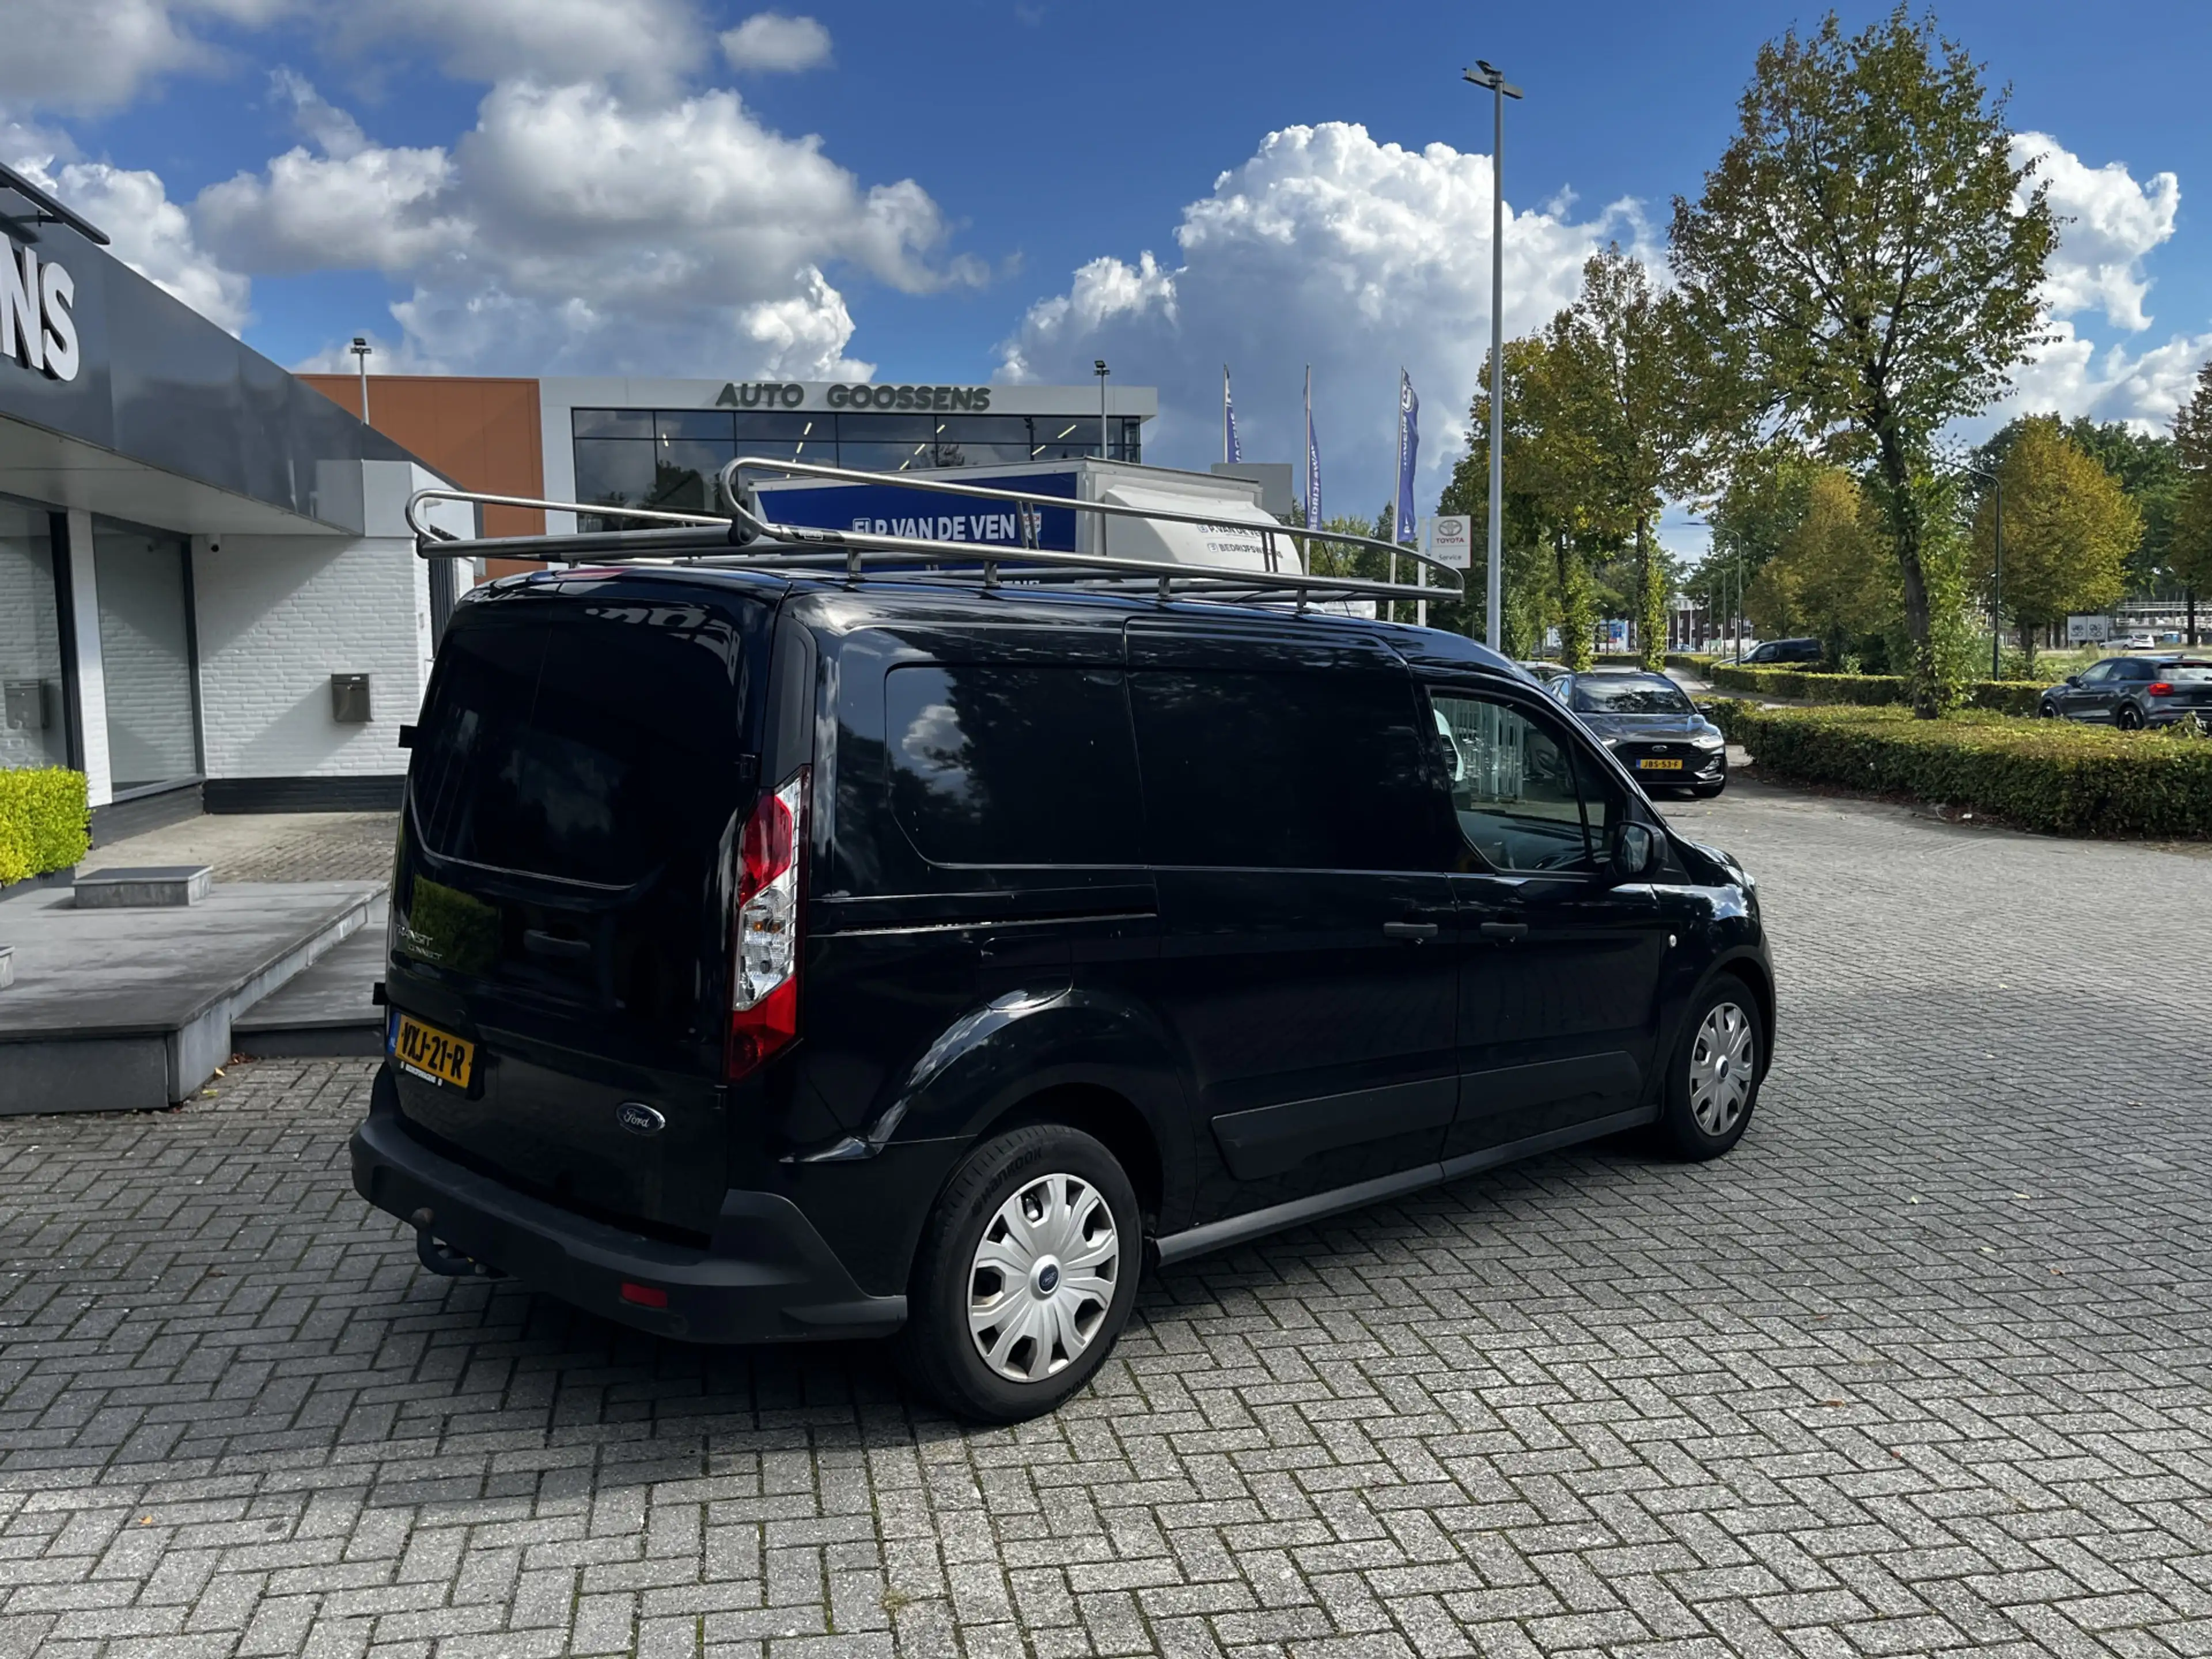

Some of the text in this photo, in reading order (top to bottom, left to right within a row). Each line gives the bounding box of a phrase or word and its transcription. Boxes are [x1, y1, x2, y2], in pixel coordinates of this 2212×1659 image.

[715, 383, 991, 412] AUTO GOOSSENS
[893, 518, 933, 540] VAN
[938, 516, 965, 541] DE
[970, 513, 1015, 540] VEN
[402, 1021, 465, 1081] VXJ-21-R
[623, 1108, 650, 1128] Ford
